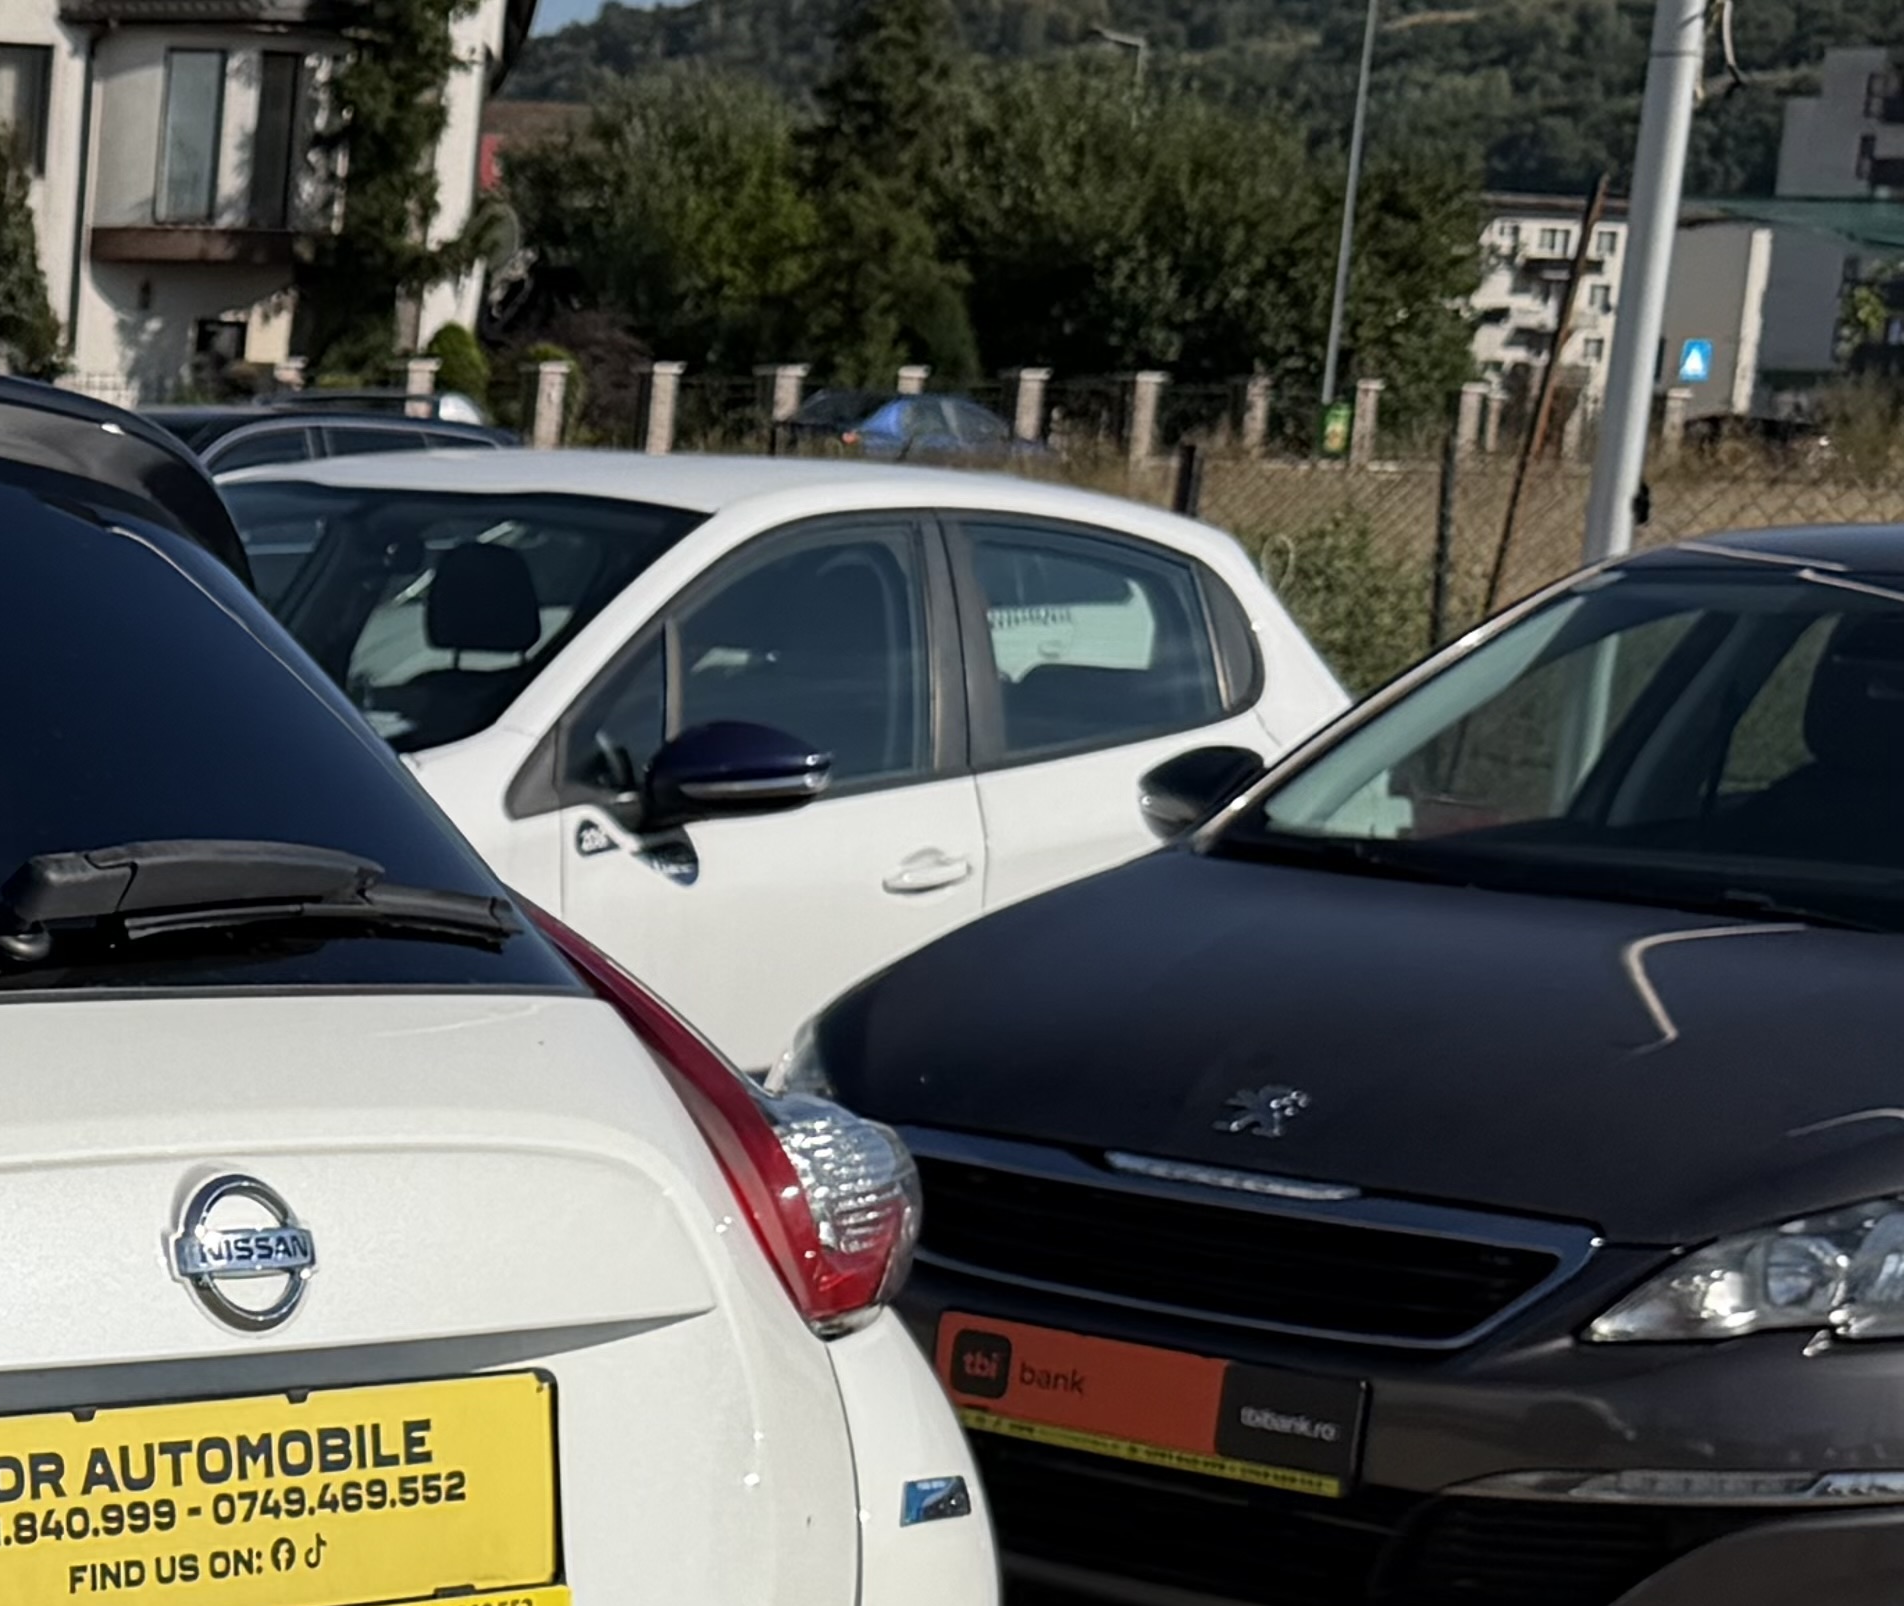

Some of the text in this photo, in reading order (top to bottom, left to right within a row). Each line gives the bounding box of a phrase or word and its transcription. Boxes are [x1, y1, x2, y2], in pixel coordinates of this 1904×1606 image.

[198, 1235, 309, 1264] NISSAN
[962, 1351, 1085, 1394] tbi bank
[81, 1418, 433, 1495] AUTOMOBILE
[212, 1470, 466, 1525] 0749.469.552
[68, 1547, 263, 1594] FIND US ON:
